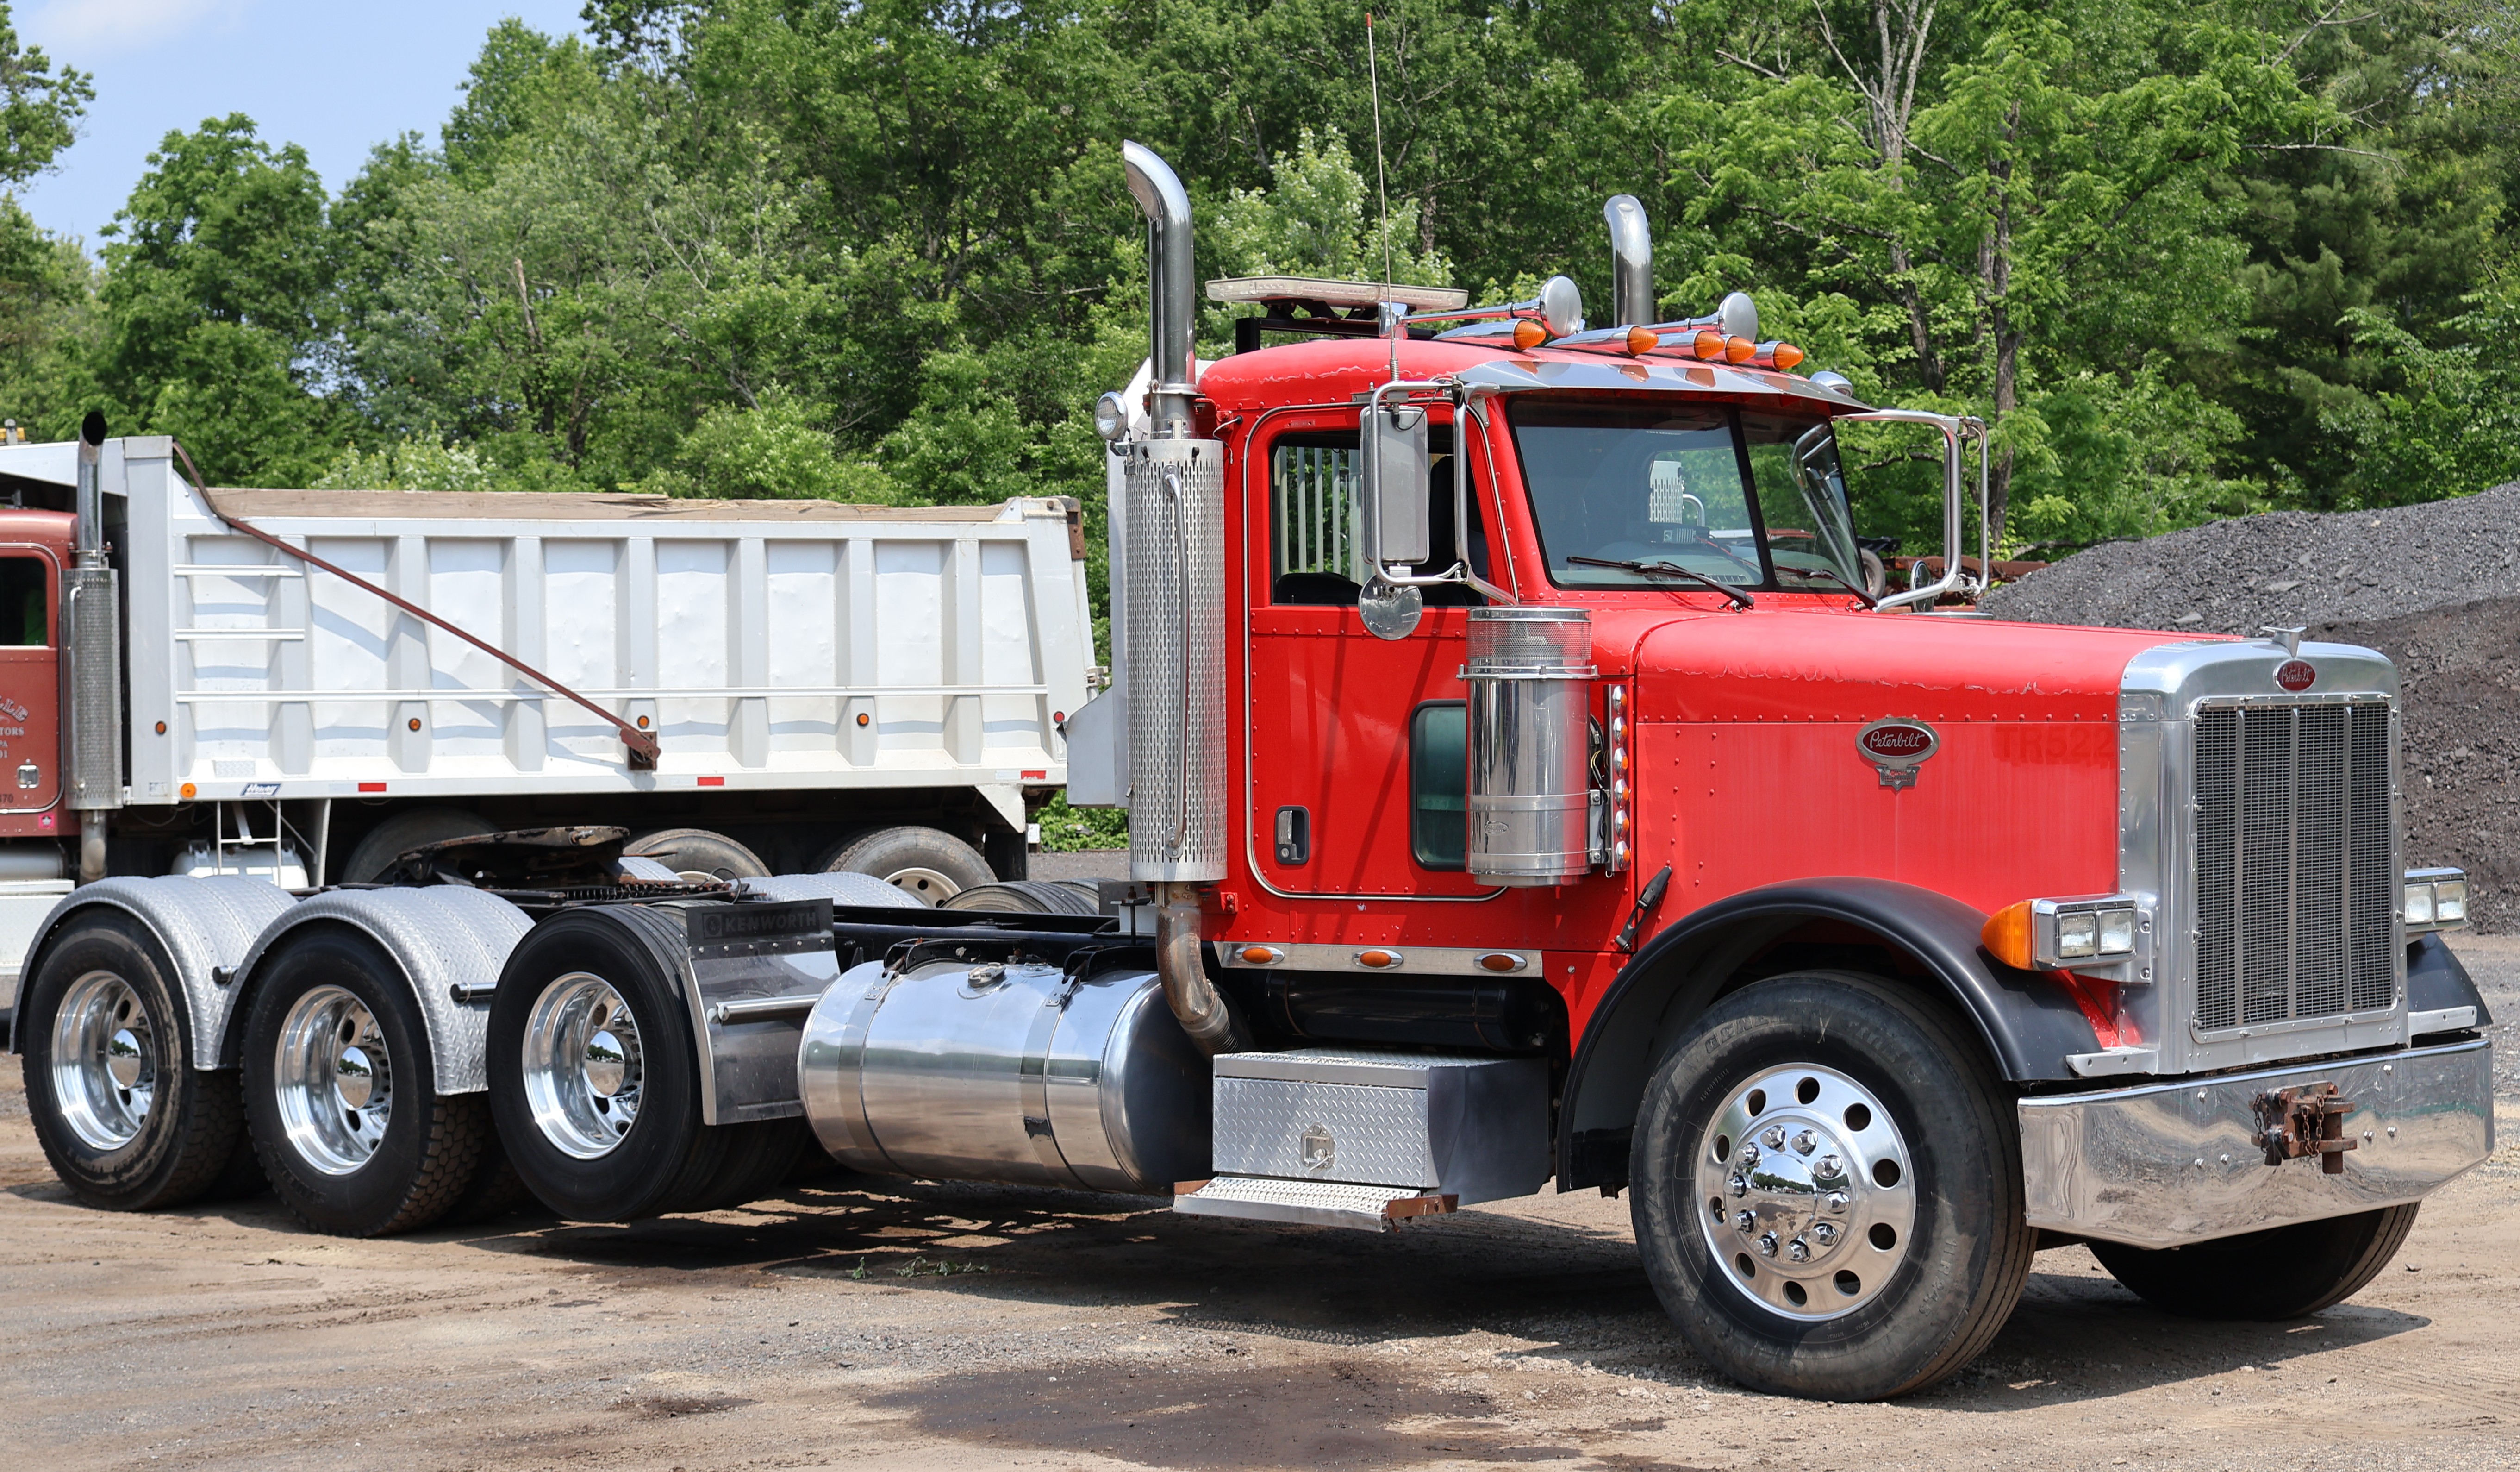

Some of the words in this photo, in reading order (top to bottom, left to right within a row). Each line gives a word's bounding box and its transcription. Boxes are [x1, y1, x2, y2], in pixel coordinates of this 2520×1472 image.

[2282, 666, 2312, 684] Peterbilt
[1870, 731, 1925, 749] Peterbilt
[725, 912, 817, 932] KENWORTH
